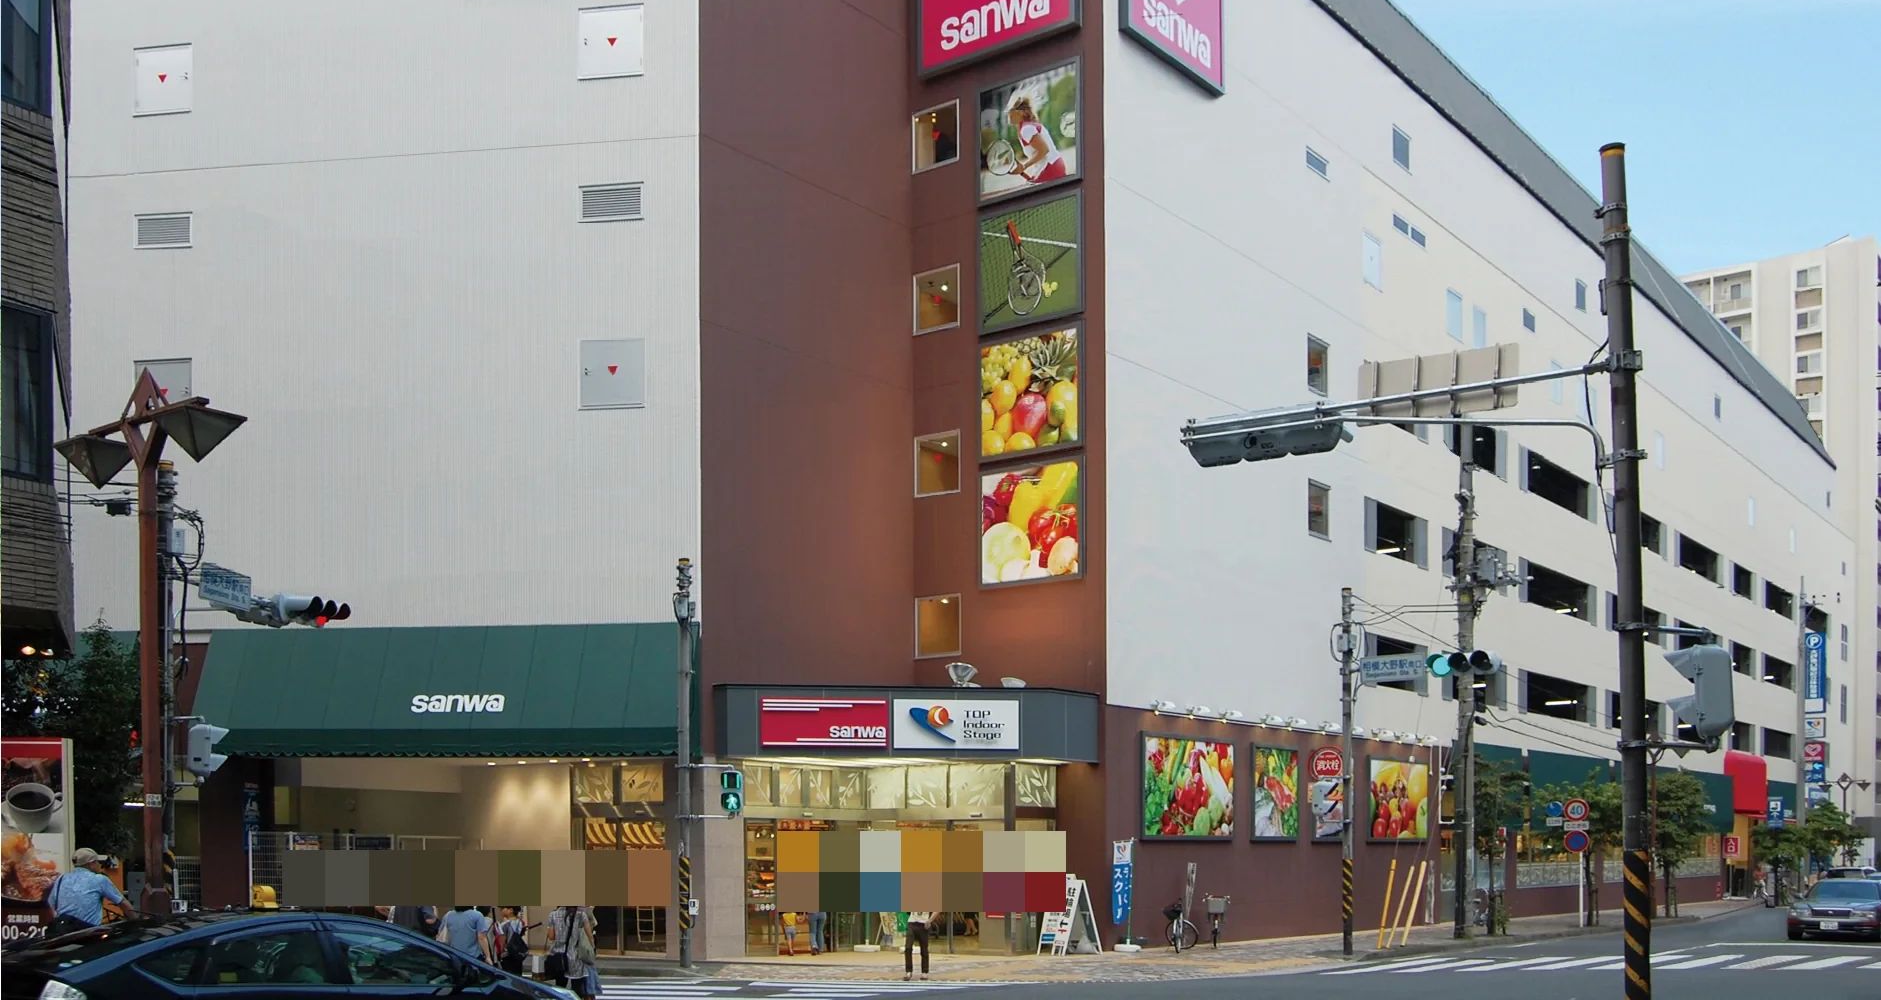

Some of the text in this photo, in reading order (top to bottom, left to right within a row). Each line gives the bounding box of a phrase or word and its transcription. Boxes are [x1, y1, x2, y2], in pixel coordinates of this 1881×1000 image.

[410, 694, 506, 712] sanwa
[963, 709, 991, 719] TOP
[963, 720, 1005, 729] Indoor
[829, 725, 887, 738] sanwa
[963, 730, 1002, 740] Stage
[1316, 759, 1340, 771] 消火栓
[1569, 804, 1585, 816] 40
[1727, 838, 1736, 853] 入口
[1113, 868, 1124, 919] スクール
